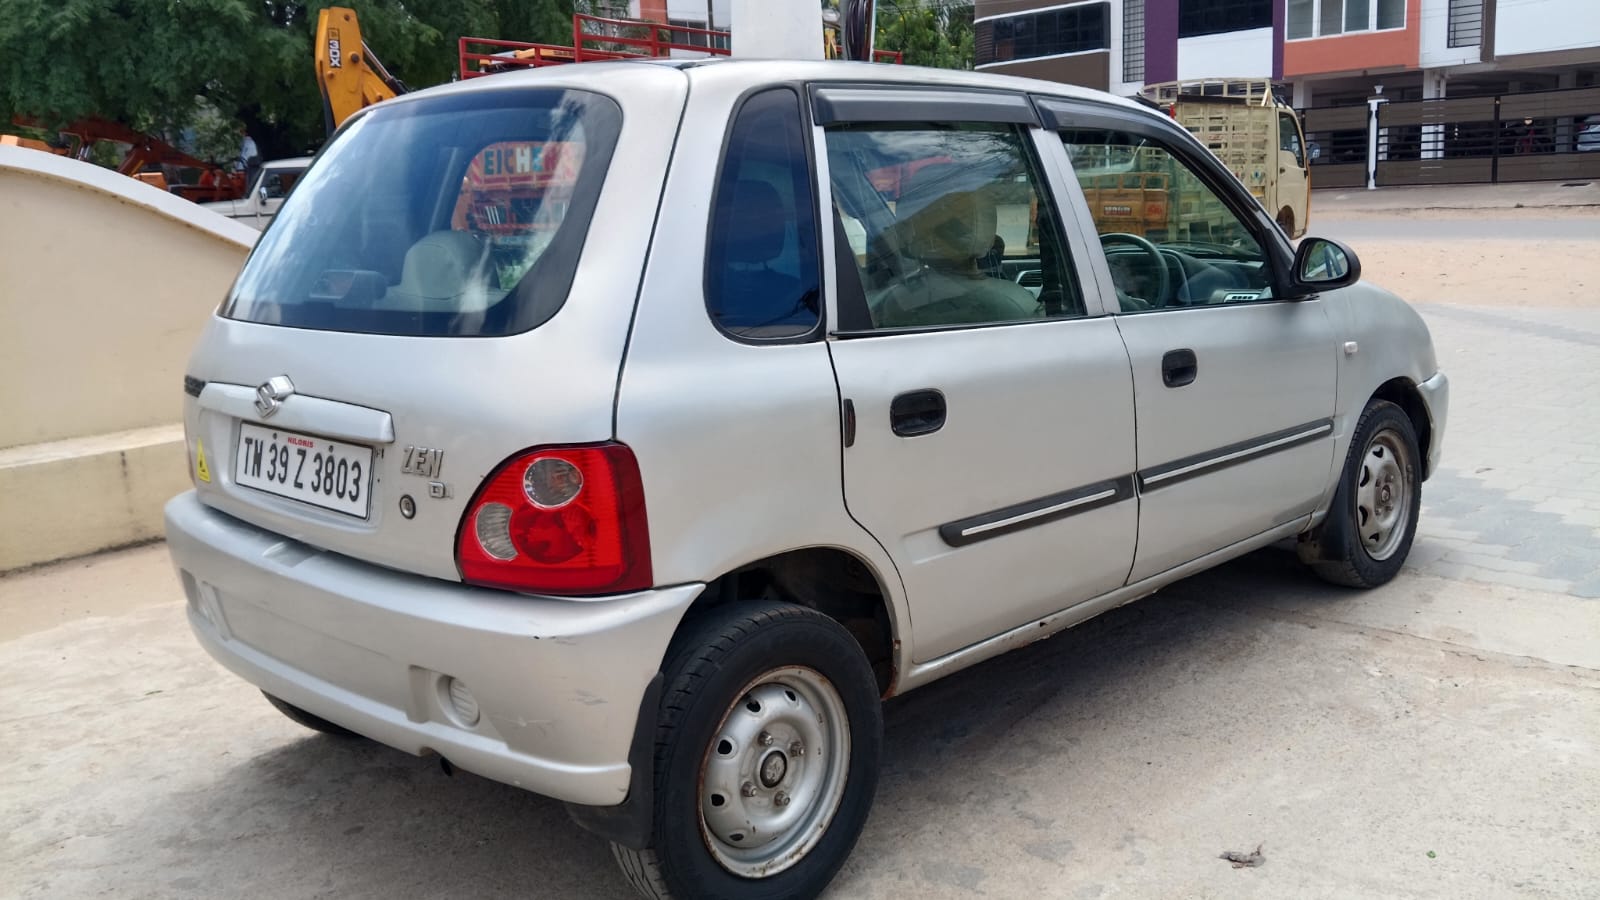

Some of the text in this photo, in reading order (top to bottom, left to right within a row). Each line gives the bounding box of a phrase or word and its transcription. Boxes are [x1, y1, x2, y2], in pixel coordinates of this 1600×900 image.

[329, 40, 341, 67] 3DX
[244, 436, 362, 502] TN 39 Z 3803
[402, 445, 444, 478] ZEN
